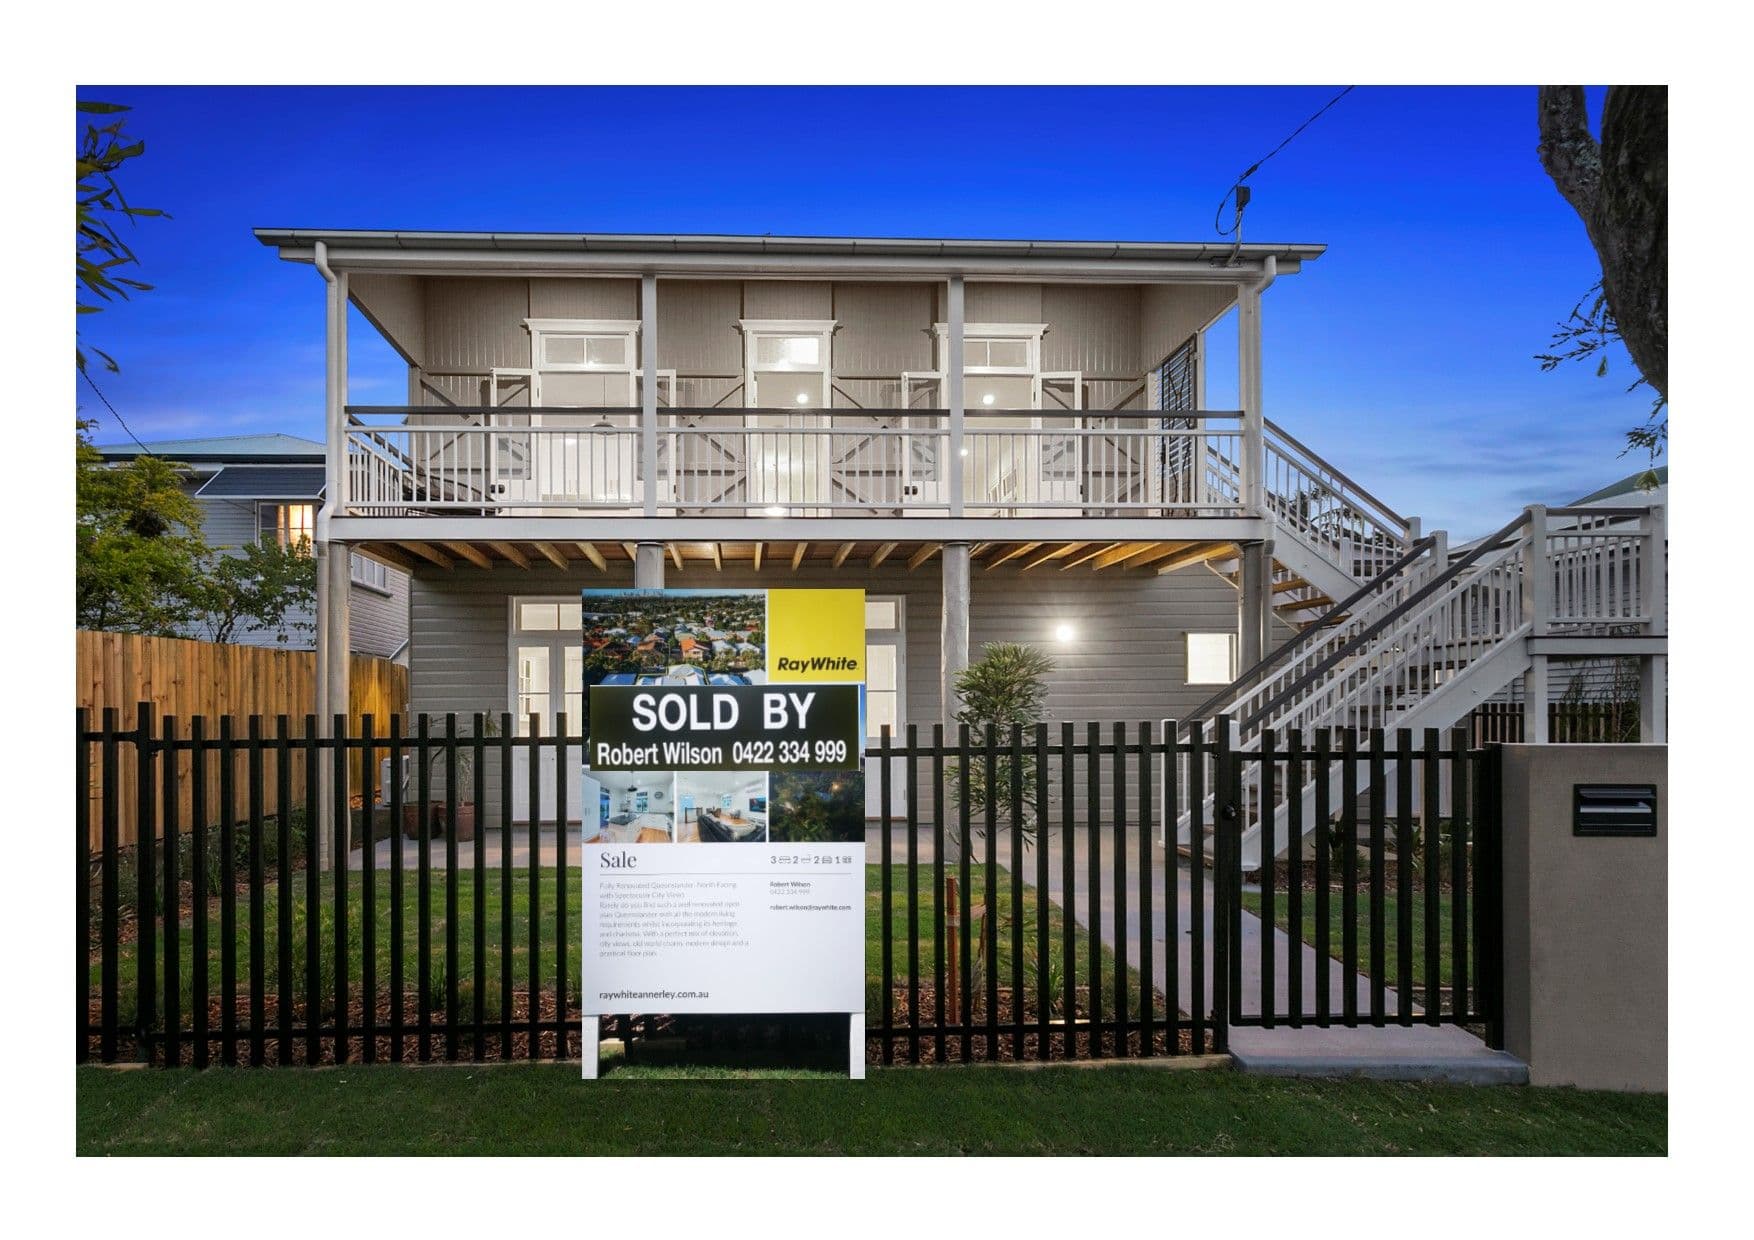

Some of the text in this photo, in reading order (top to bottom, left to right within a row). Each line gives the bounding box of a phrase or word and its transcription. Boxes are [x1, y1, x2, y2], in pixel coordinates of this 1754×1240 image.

[777, 657, 858, 673] RayWhite
[632, 693, 816, 731] SOLD BY
[597, 740, 847, 765] Robert Wilson 0422 334 999
[600, 851, 638, 868] Sale
[770, 856, 841, 864] 3 2 2 1
[599, 989, 709, 1000] raywhiteannerley.com.au
